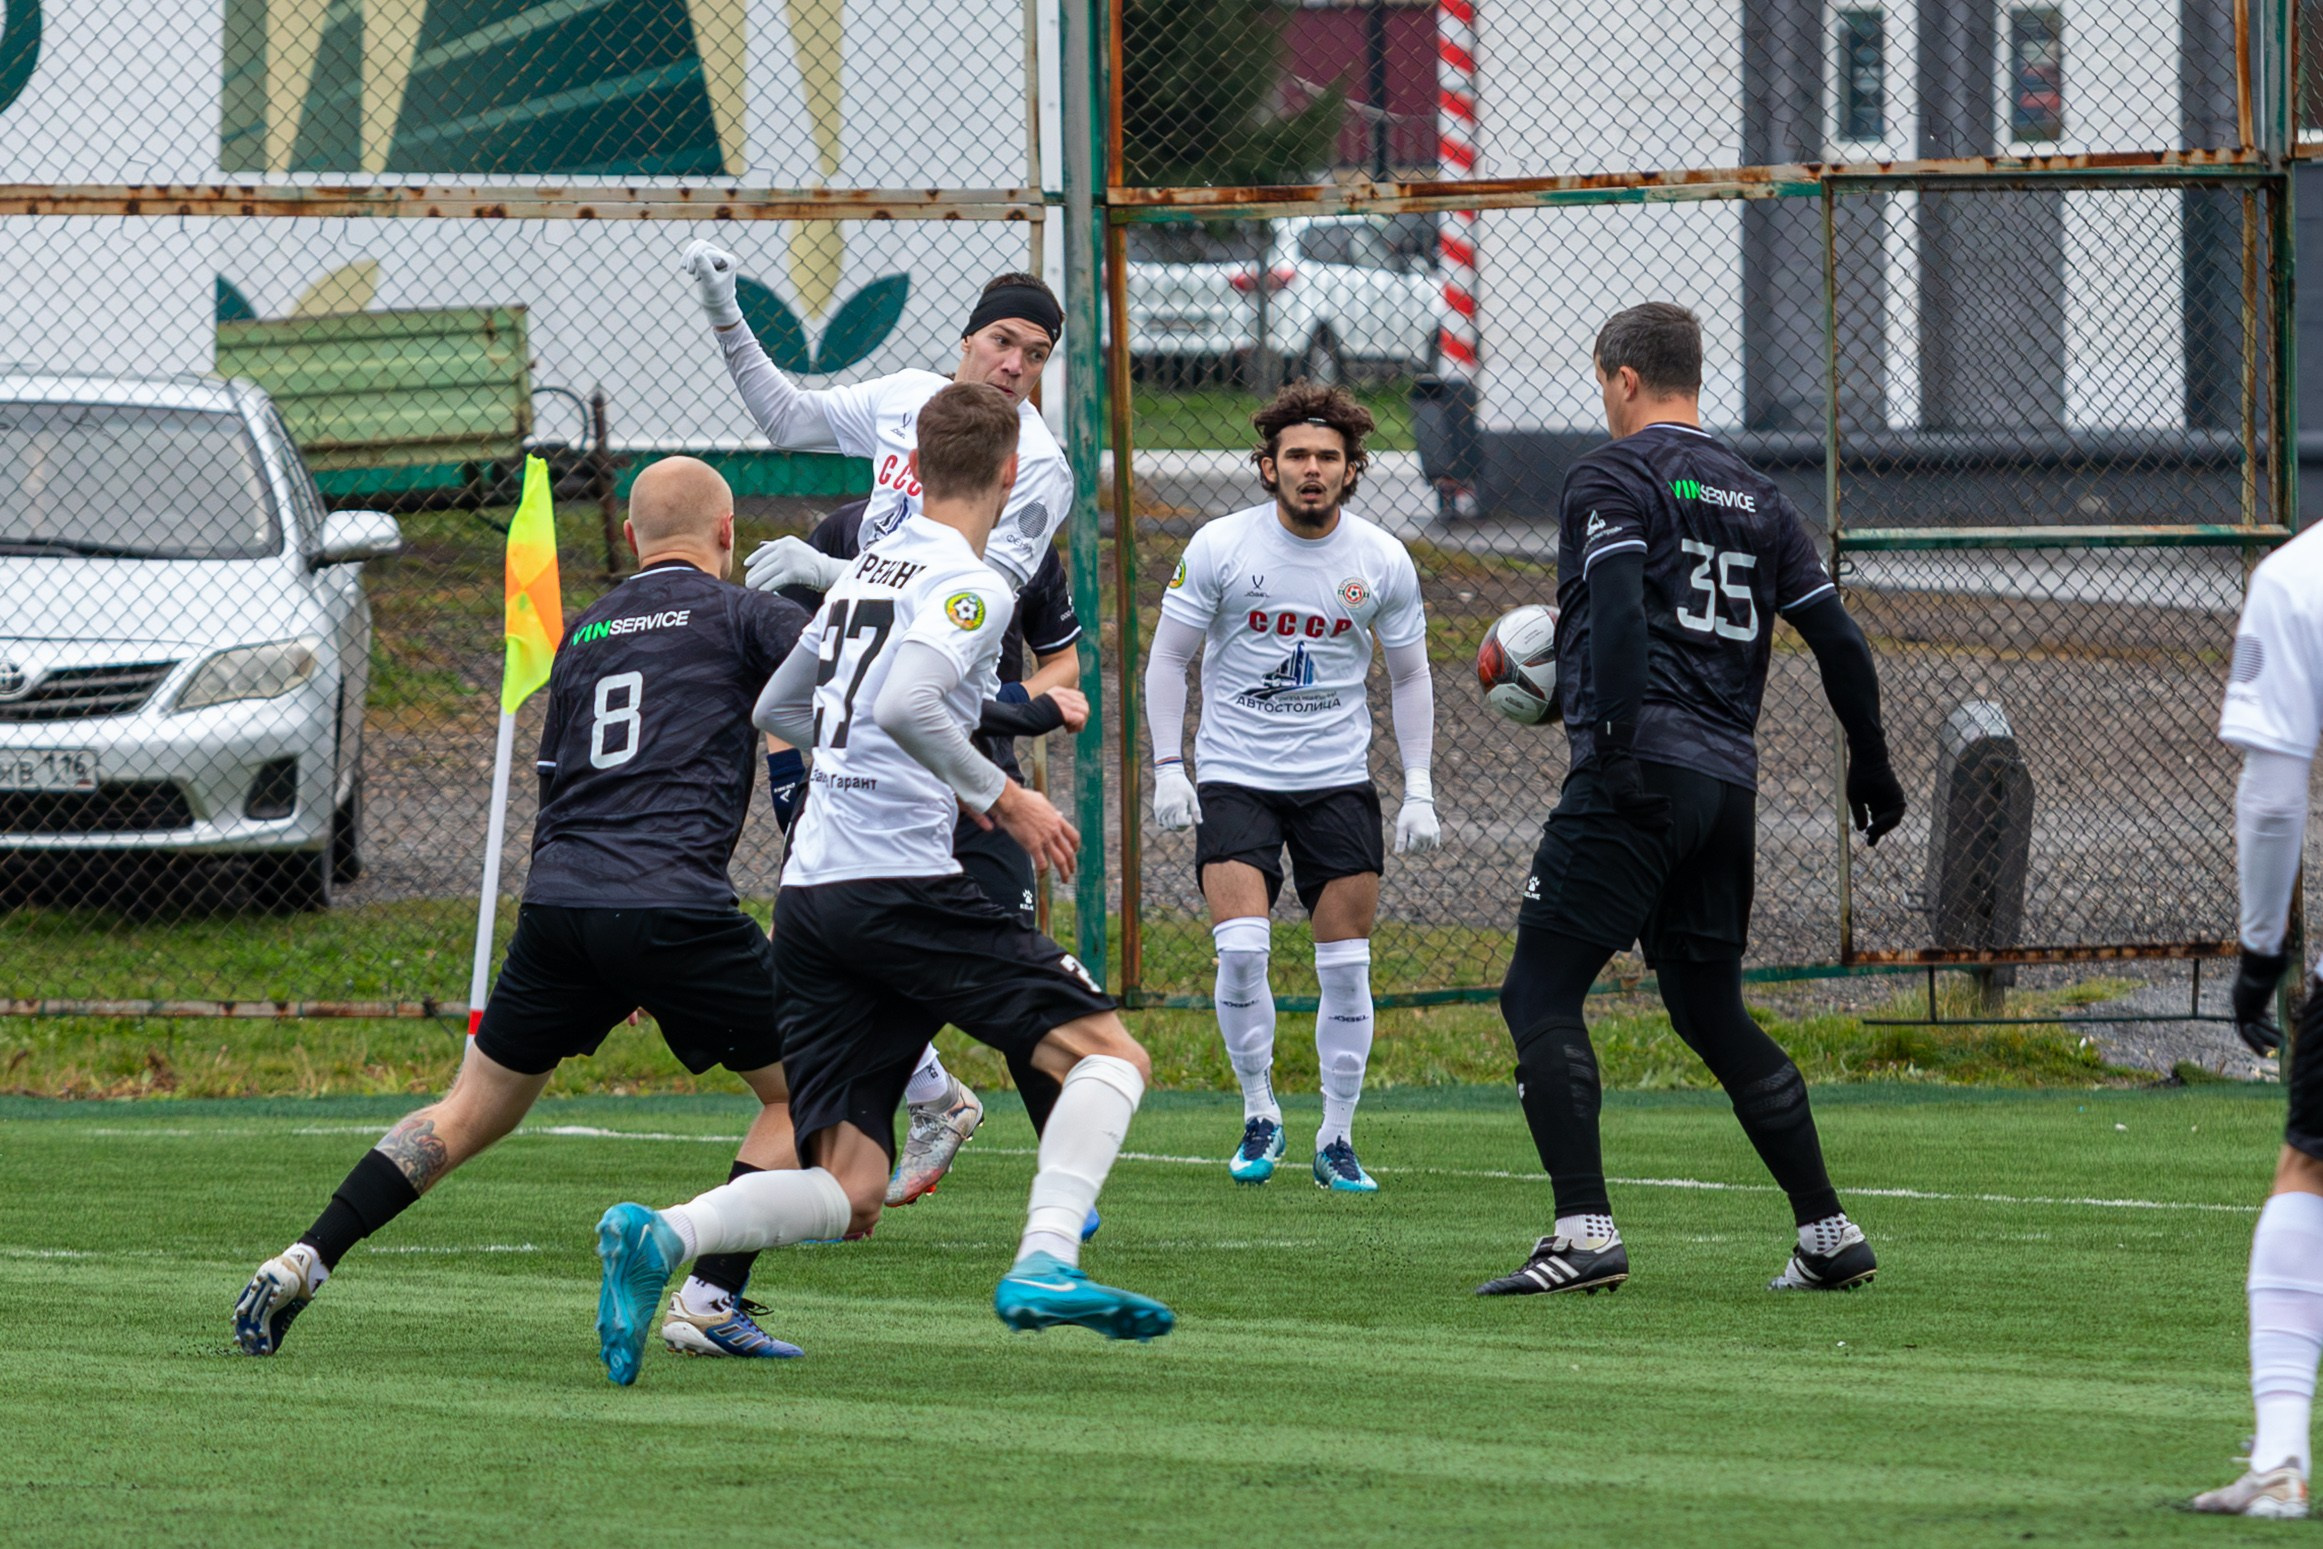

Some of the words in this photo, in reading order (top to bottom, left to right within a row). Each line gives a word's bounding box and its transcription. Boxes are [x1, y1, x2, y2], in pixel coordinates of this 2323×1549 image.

[1667, 479, 1756, 513] VINSERVICE
[1676, 538, 1759, 642] 35
[573, 610, 691, 646] VINSERVICE
[1248, 609, 1353, 638] СССР
[590, 670, 643, 770] 8
[1236, 695, 1342, 713] АВТОСТОЛИЦА
[830, 773, 878, 792] Гарант
